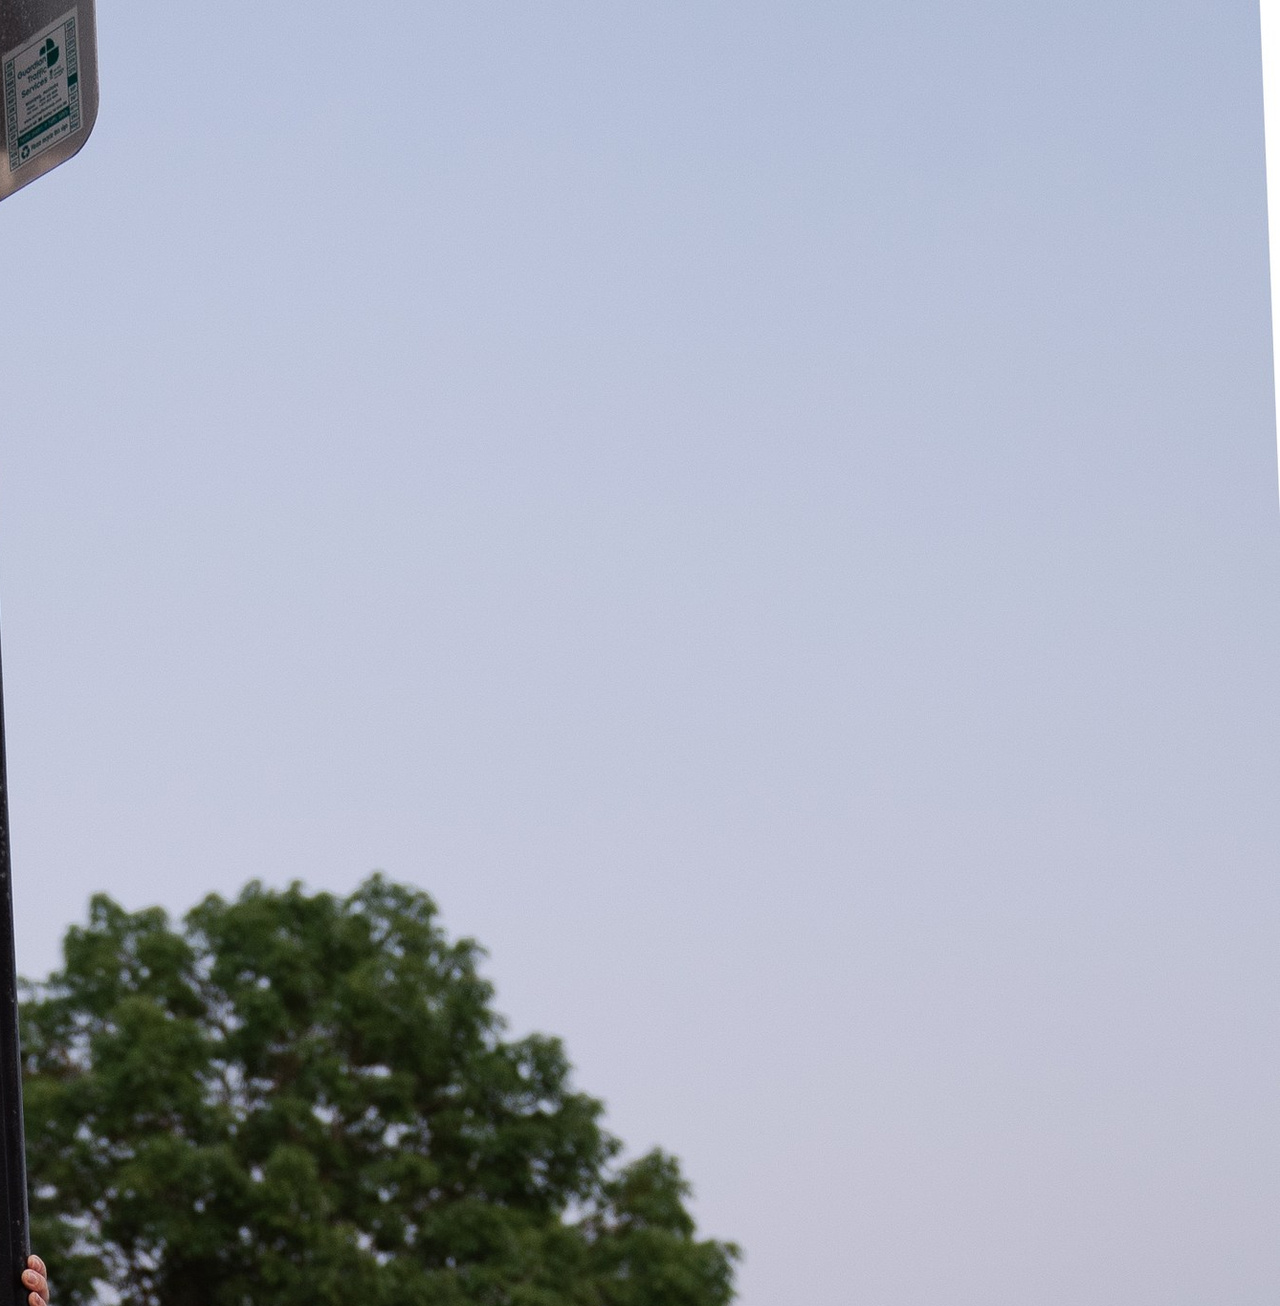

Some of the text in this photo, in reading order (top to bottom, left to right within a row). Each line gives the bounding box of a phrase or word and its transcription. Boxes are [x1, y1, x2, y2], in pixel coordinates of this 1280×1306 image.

[17, 56, 47, 80] Guardian
[28, 66, 48, 83] Traffic
[21, 77, 48, 98] Services
